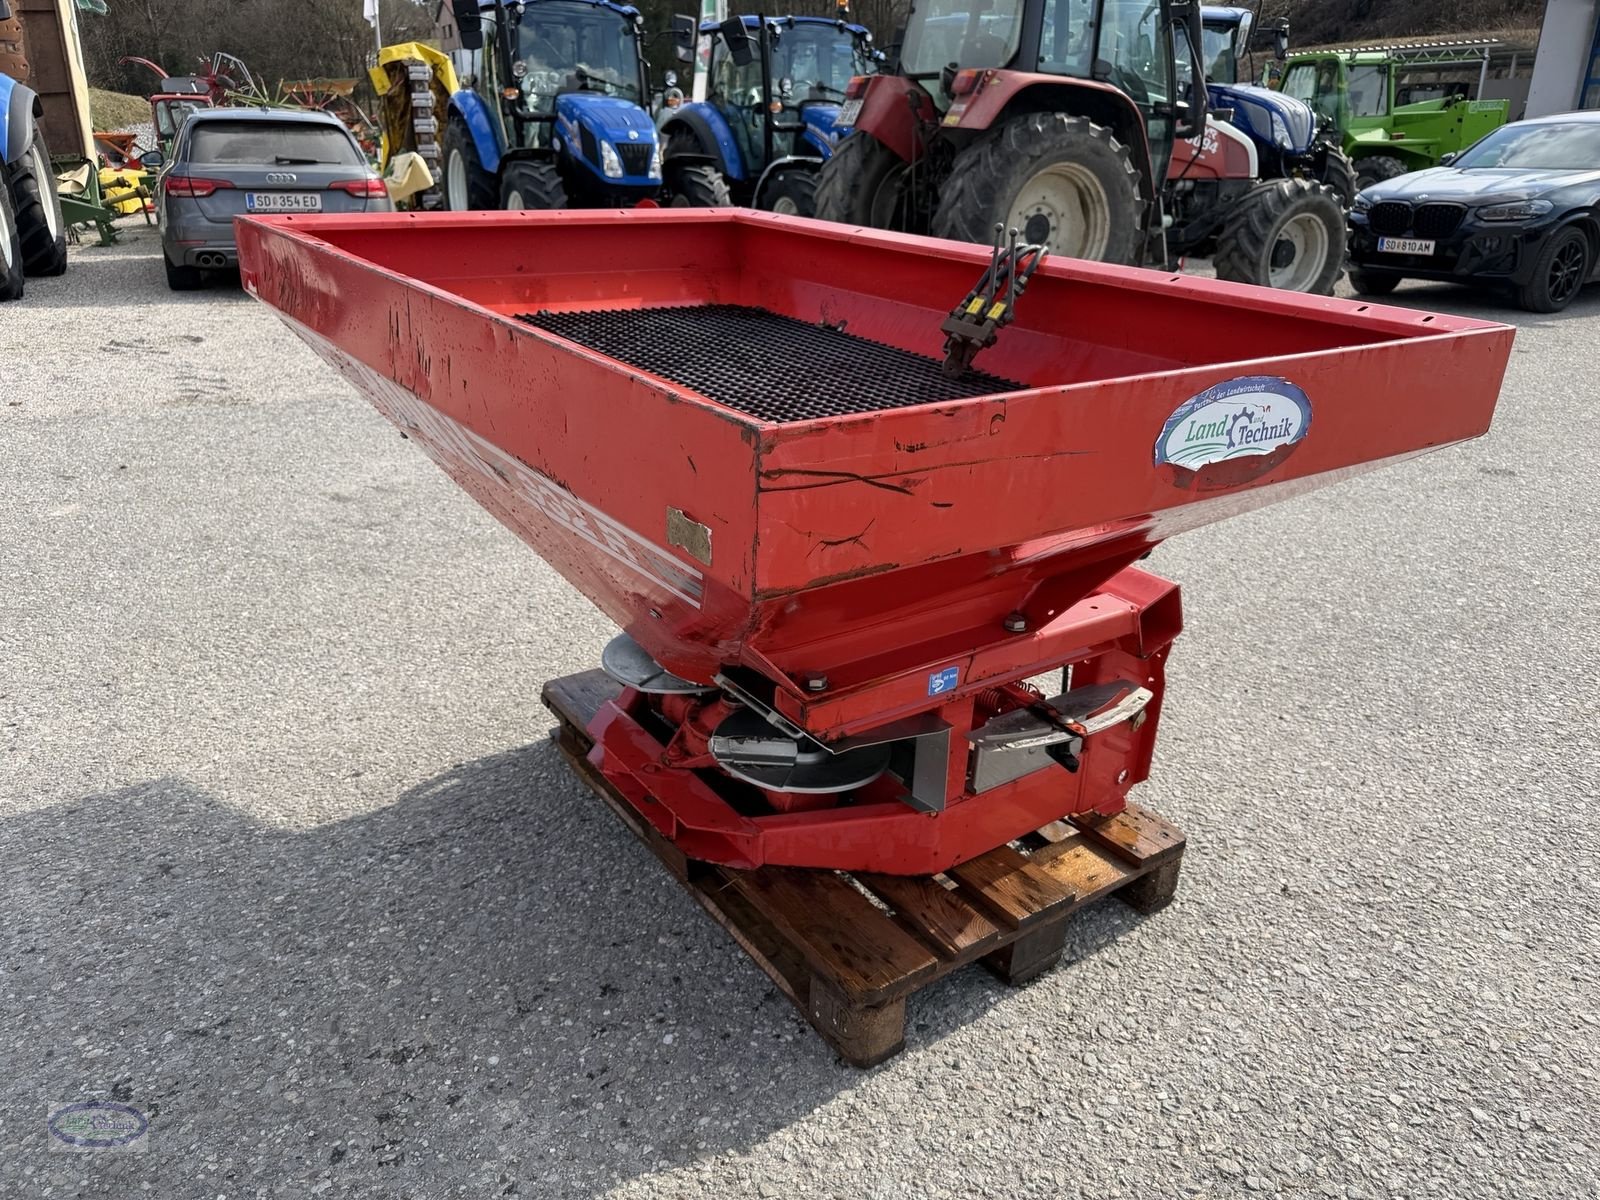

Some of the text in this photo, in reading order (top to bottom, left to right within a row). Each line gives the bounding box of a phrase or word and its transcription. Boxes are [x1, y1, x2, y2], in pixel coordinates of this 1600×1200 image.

[256, 195, 317, 207] SD 354 ED
[1385, 239, 1396, 250] SD
[1226, 383, 1266, 397] Landwirtschaft
[1184, 414, 1293, 446] Land und Technik
